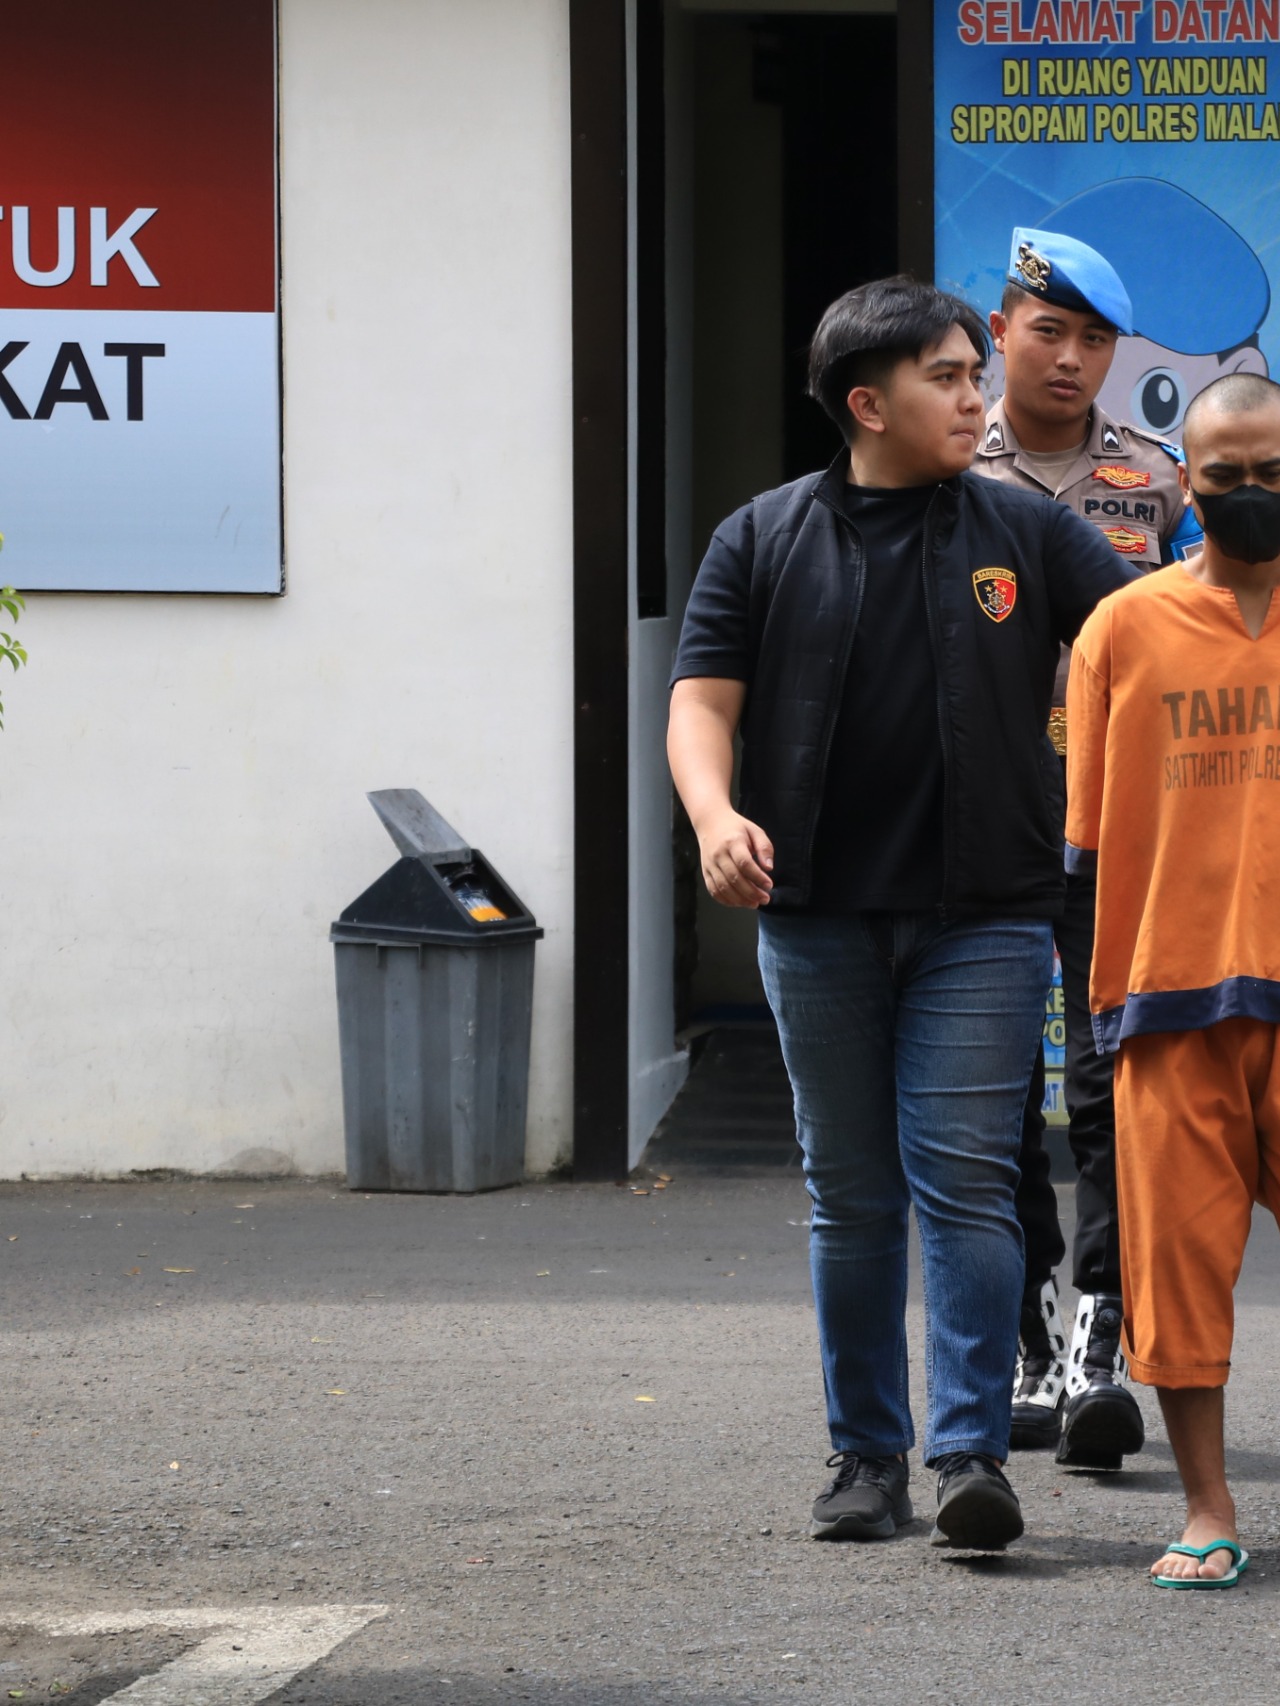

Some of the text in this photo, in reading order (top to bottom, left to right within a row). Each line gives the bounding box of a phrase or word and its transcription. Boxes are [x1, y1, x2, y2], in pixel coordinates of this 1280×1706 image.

[958, 0, 1140, 44] SELAMAT
[1003, 56, 1267, 97] DI RUANG YANDUAN
[951, 104, 1088, 143] SIPROPAM
[1094, 103, 1198, 142] POLRES
[0, 206, 160, 287] UK
[1084, 499, 1156, 523] POLRI
[1165, 751, 1234, 791] SATTAHTI
